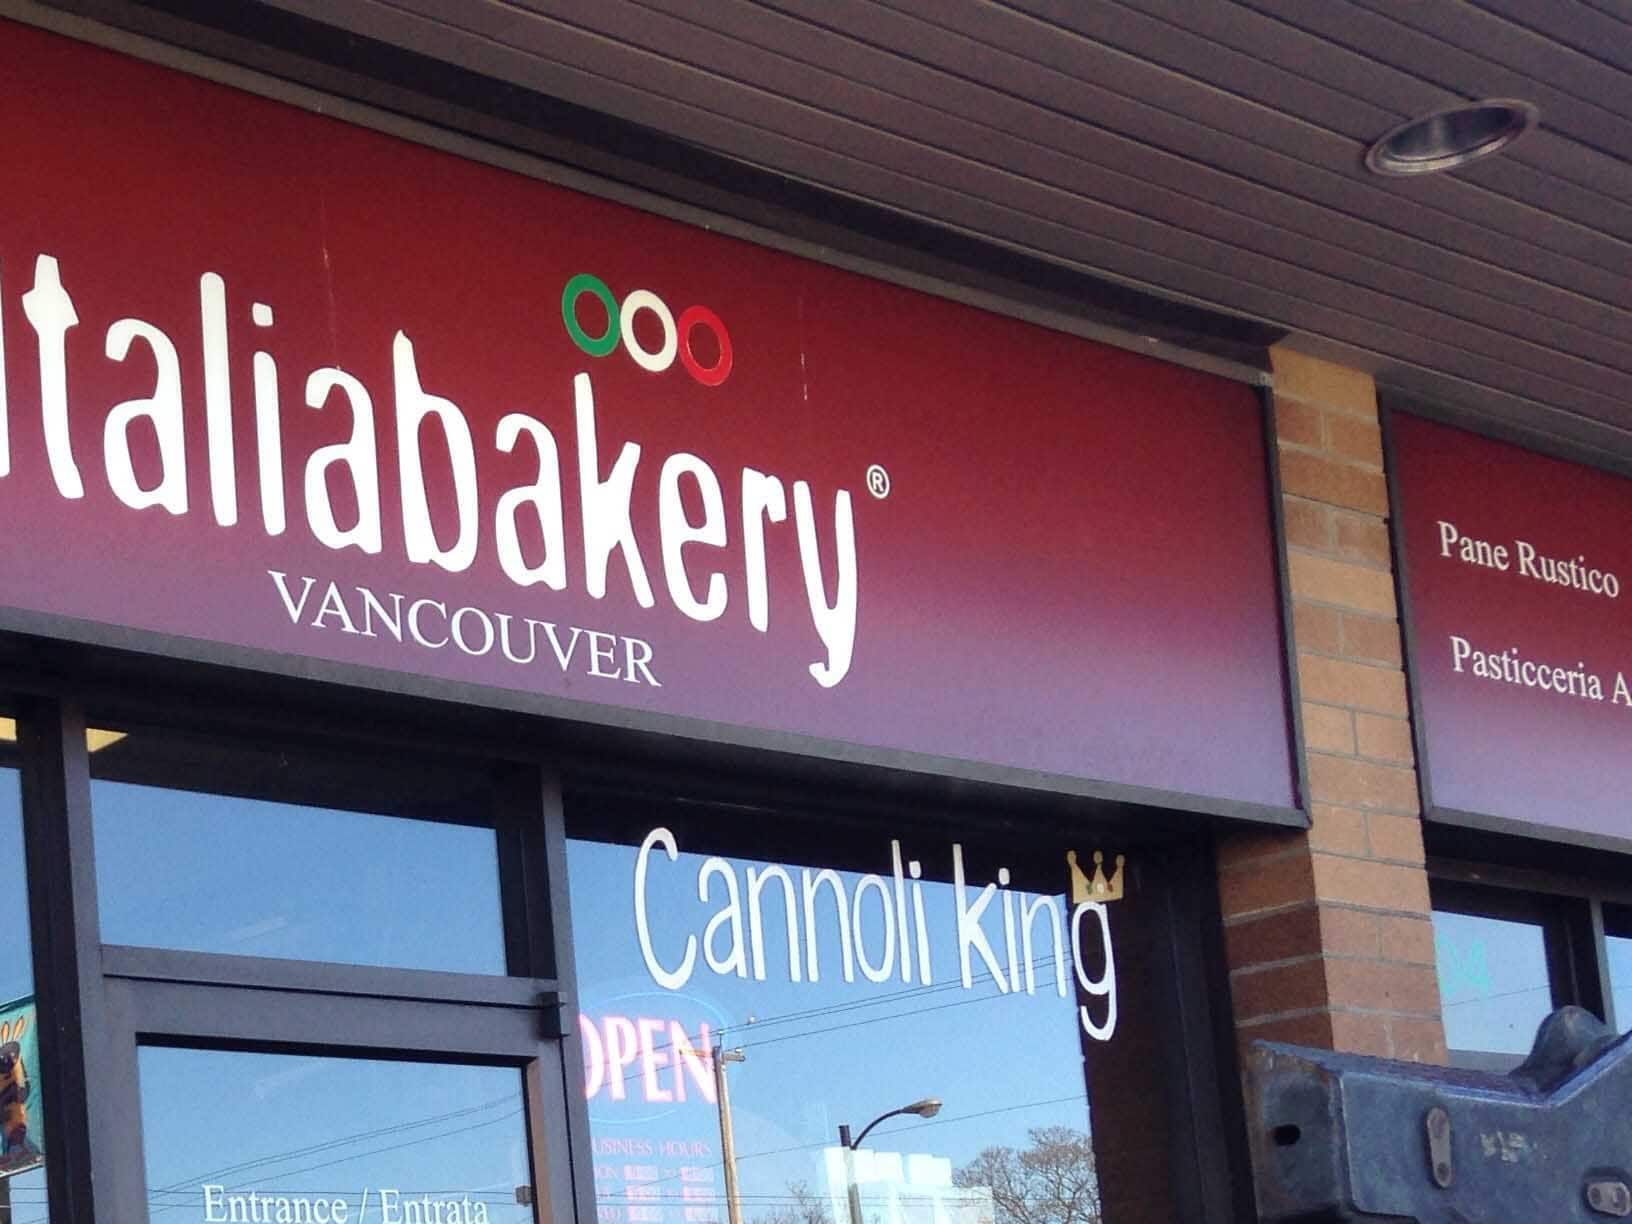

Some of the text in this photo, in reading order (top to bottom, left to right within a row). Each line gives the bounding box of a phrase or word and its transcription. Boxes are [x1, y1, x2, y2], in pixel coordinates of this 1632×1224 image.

[1437, 521, 1620, 598] Pane Rustico
[268, 568, 661, 689] VANCOUVER
[1450, 636, 1604, 701] Pasticceria
[634, 826, 1118, 1042] Cannoli king
[202, 1184, 348, 1224] Entrance
